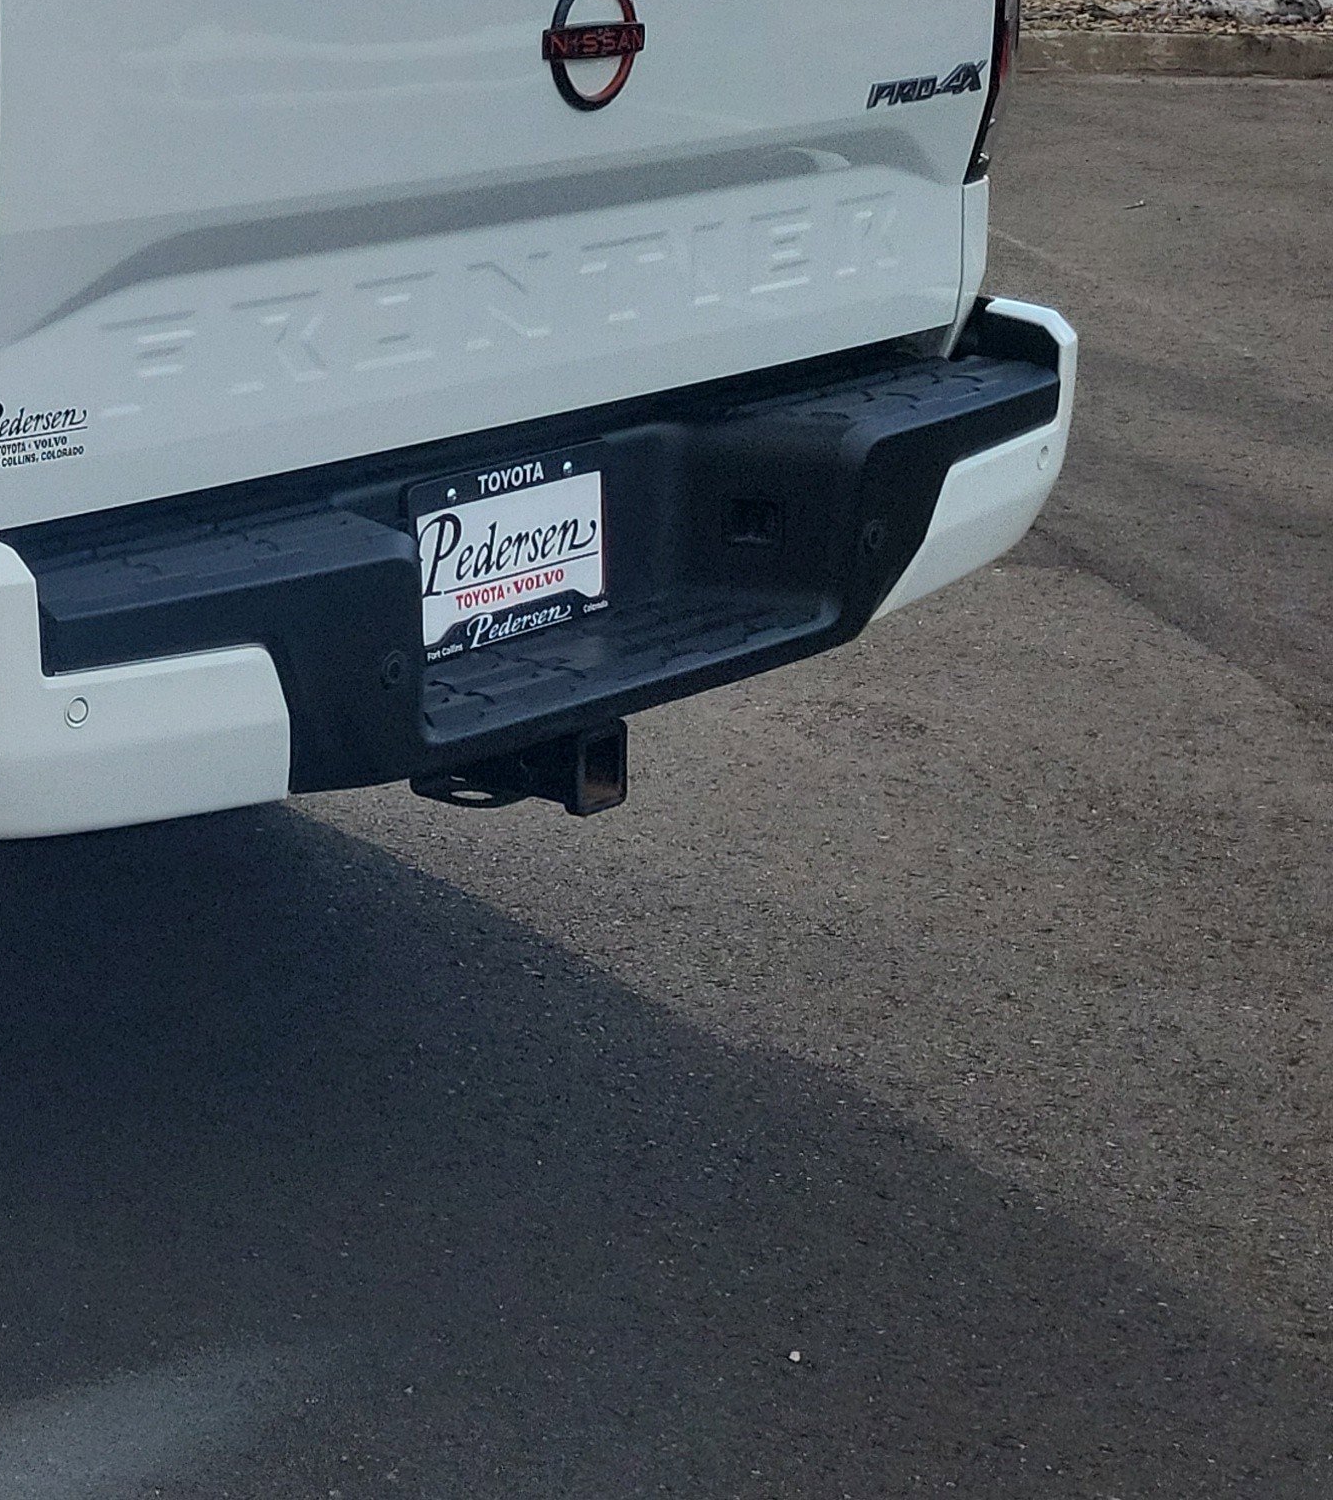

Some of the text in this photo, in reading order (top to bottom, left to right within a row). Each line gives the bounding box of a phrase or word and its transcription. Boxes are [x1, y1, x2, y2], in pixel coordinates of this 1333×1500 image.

[550, 28, 643, 56] NISSAN
[867, 59, 988, 109] PRO-4X
[1, 452, 39, 468] COLLINS,
[41, 445, 84, 461] COLORADO
[34, 435, 68, 450] VOLVO
[478, 461, 544, 494] TOYOTA
[419, 513, 597, 597] Pedersen
[455, 568, 564, 610] TOYOTA VOLVO
[466, 604, 571, 649] Pedersen
